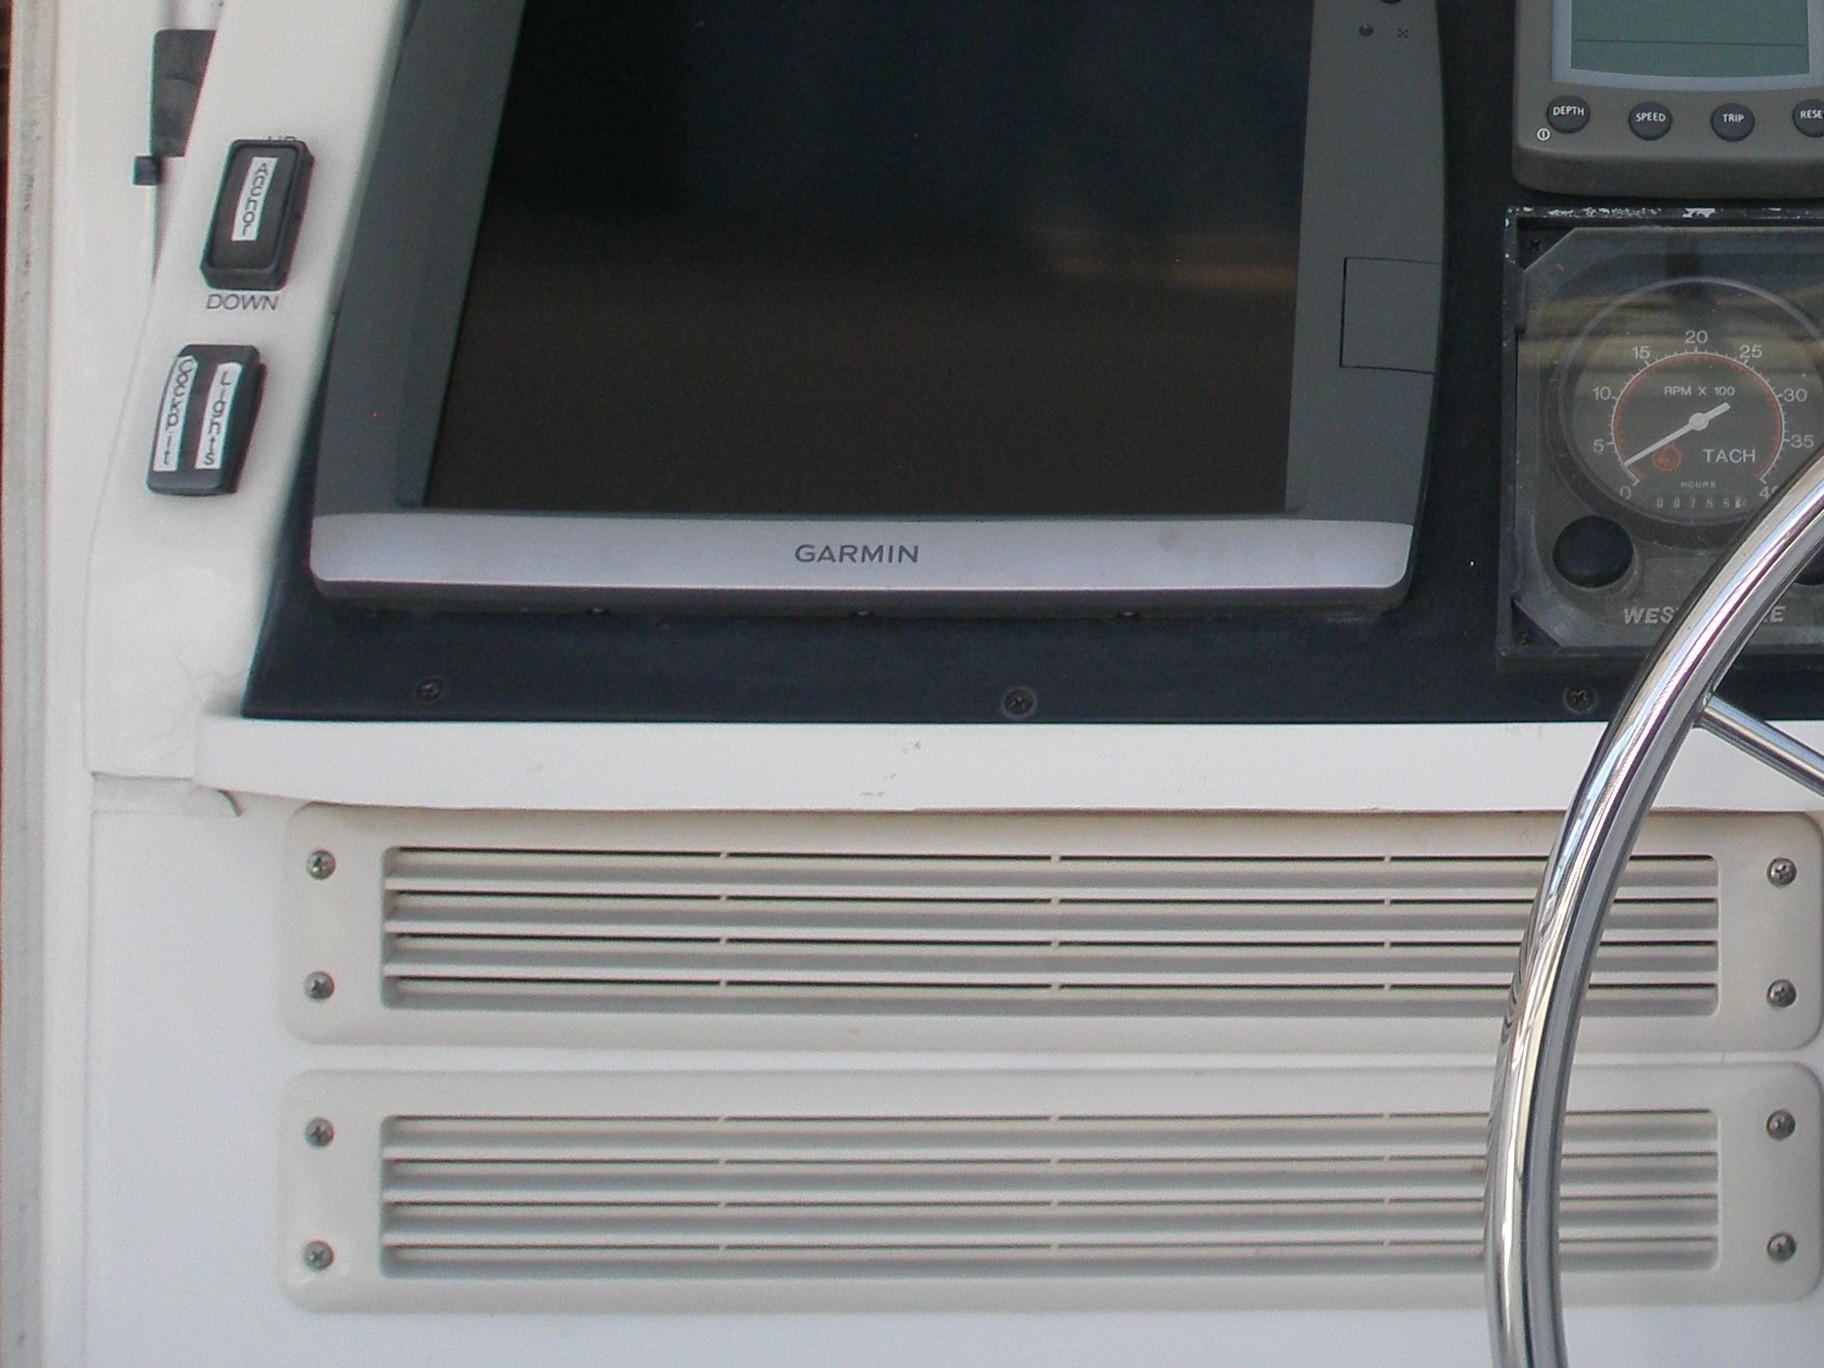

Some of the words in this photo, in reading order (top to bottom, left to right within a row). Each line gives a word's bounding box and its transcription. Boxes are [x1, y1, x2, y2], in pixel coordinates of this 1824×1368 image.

[1553, 106, 1585, 117] DEPTH
[1635, 112, 1666, 123] SPEED
[1722, 113, 1744, 124] TRIP
[206, 293, 280, 312] DOWN
[1684, 330, 1709, 344] 20
[1632, 345, 1651, 360] 15
[1740, 344, 1763, 359] 25
[1592, 386, 1612, 400] 10
[1664, 386, 1692, 396] RPM
[1714, 385, 1736, 396] 100
[1783, 388, 1808, 402] 30
[203, 370, 232, 466] Lights
[1592, 439, 1605, 452] 5
[1790, 434, 1814, 448] 35
[1703, 448, 1756, 463] TACH
[1680, 480, 1716, 489] HOURS
[1620, 486, 1631, 500] 0
[794, 543, 919, 563] GARMIN
